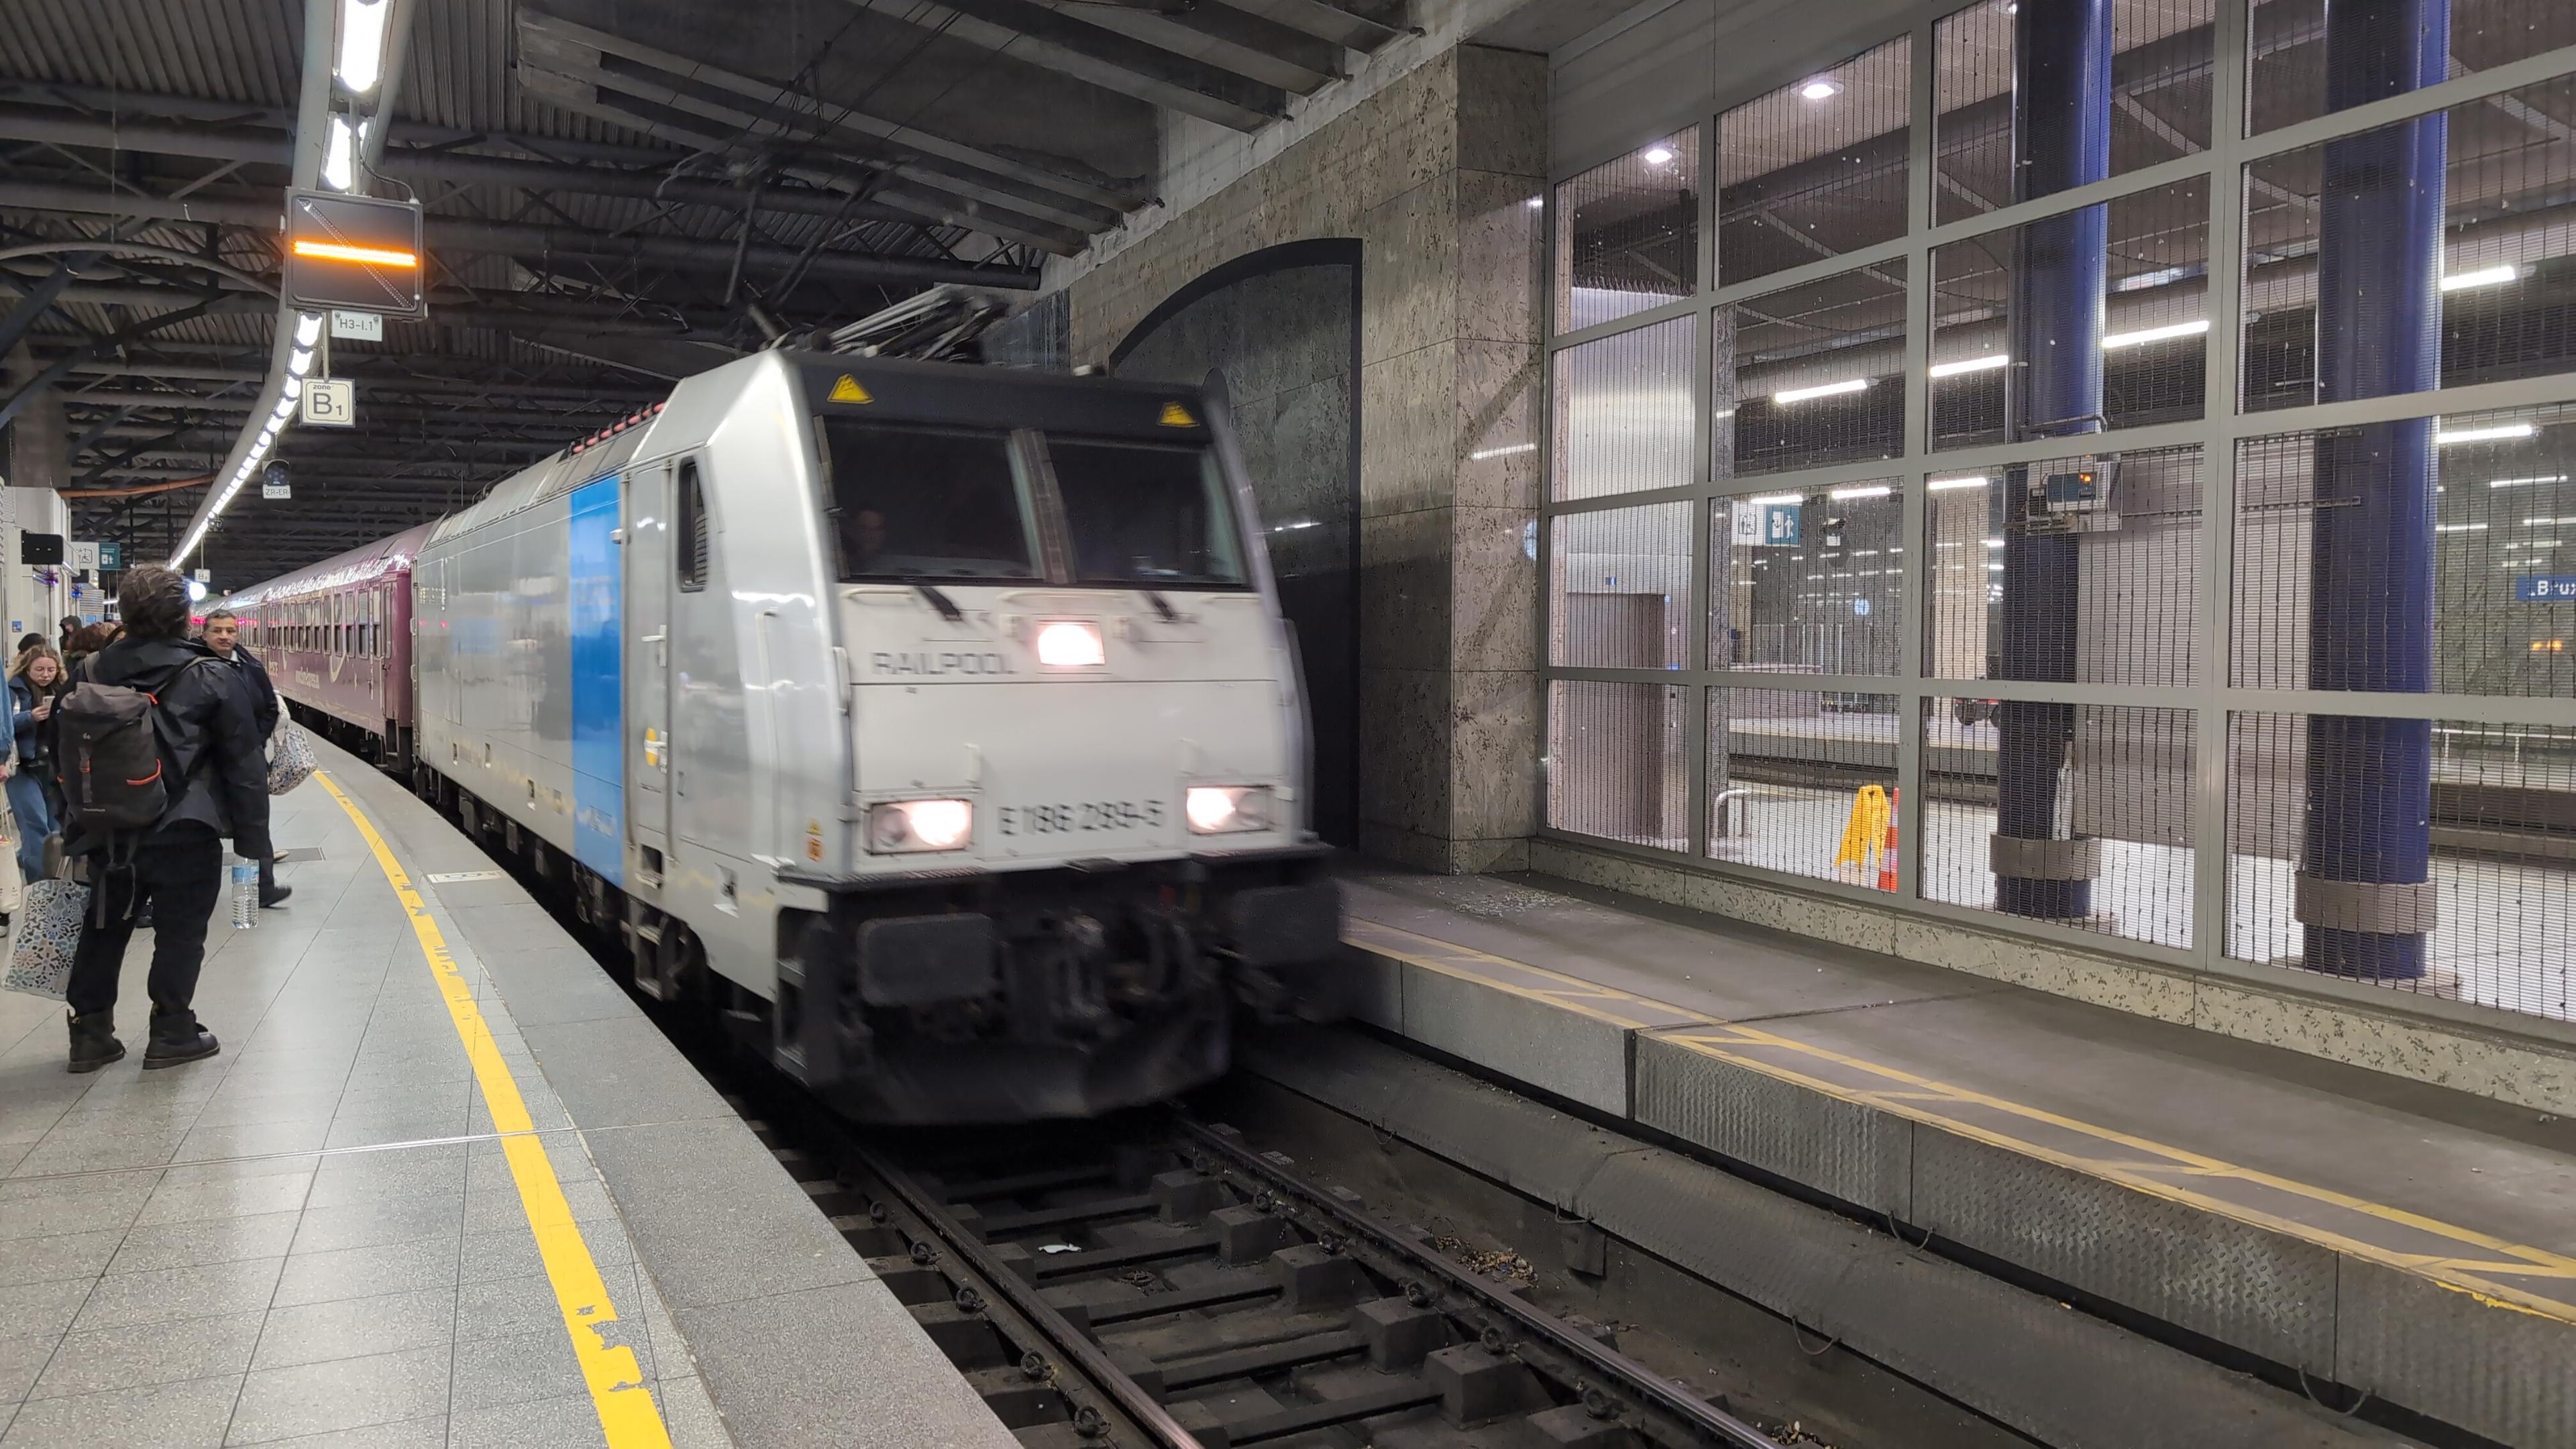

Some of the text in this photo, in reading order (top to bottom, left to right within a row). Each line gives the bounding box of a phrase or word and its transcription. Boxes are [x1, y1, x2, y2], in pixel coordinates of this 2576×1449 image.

[871, 652, 1018, 676] RAILPOOL
[998, 806, 1018, 836] E
[1022, 803, 1074, 836] 186
